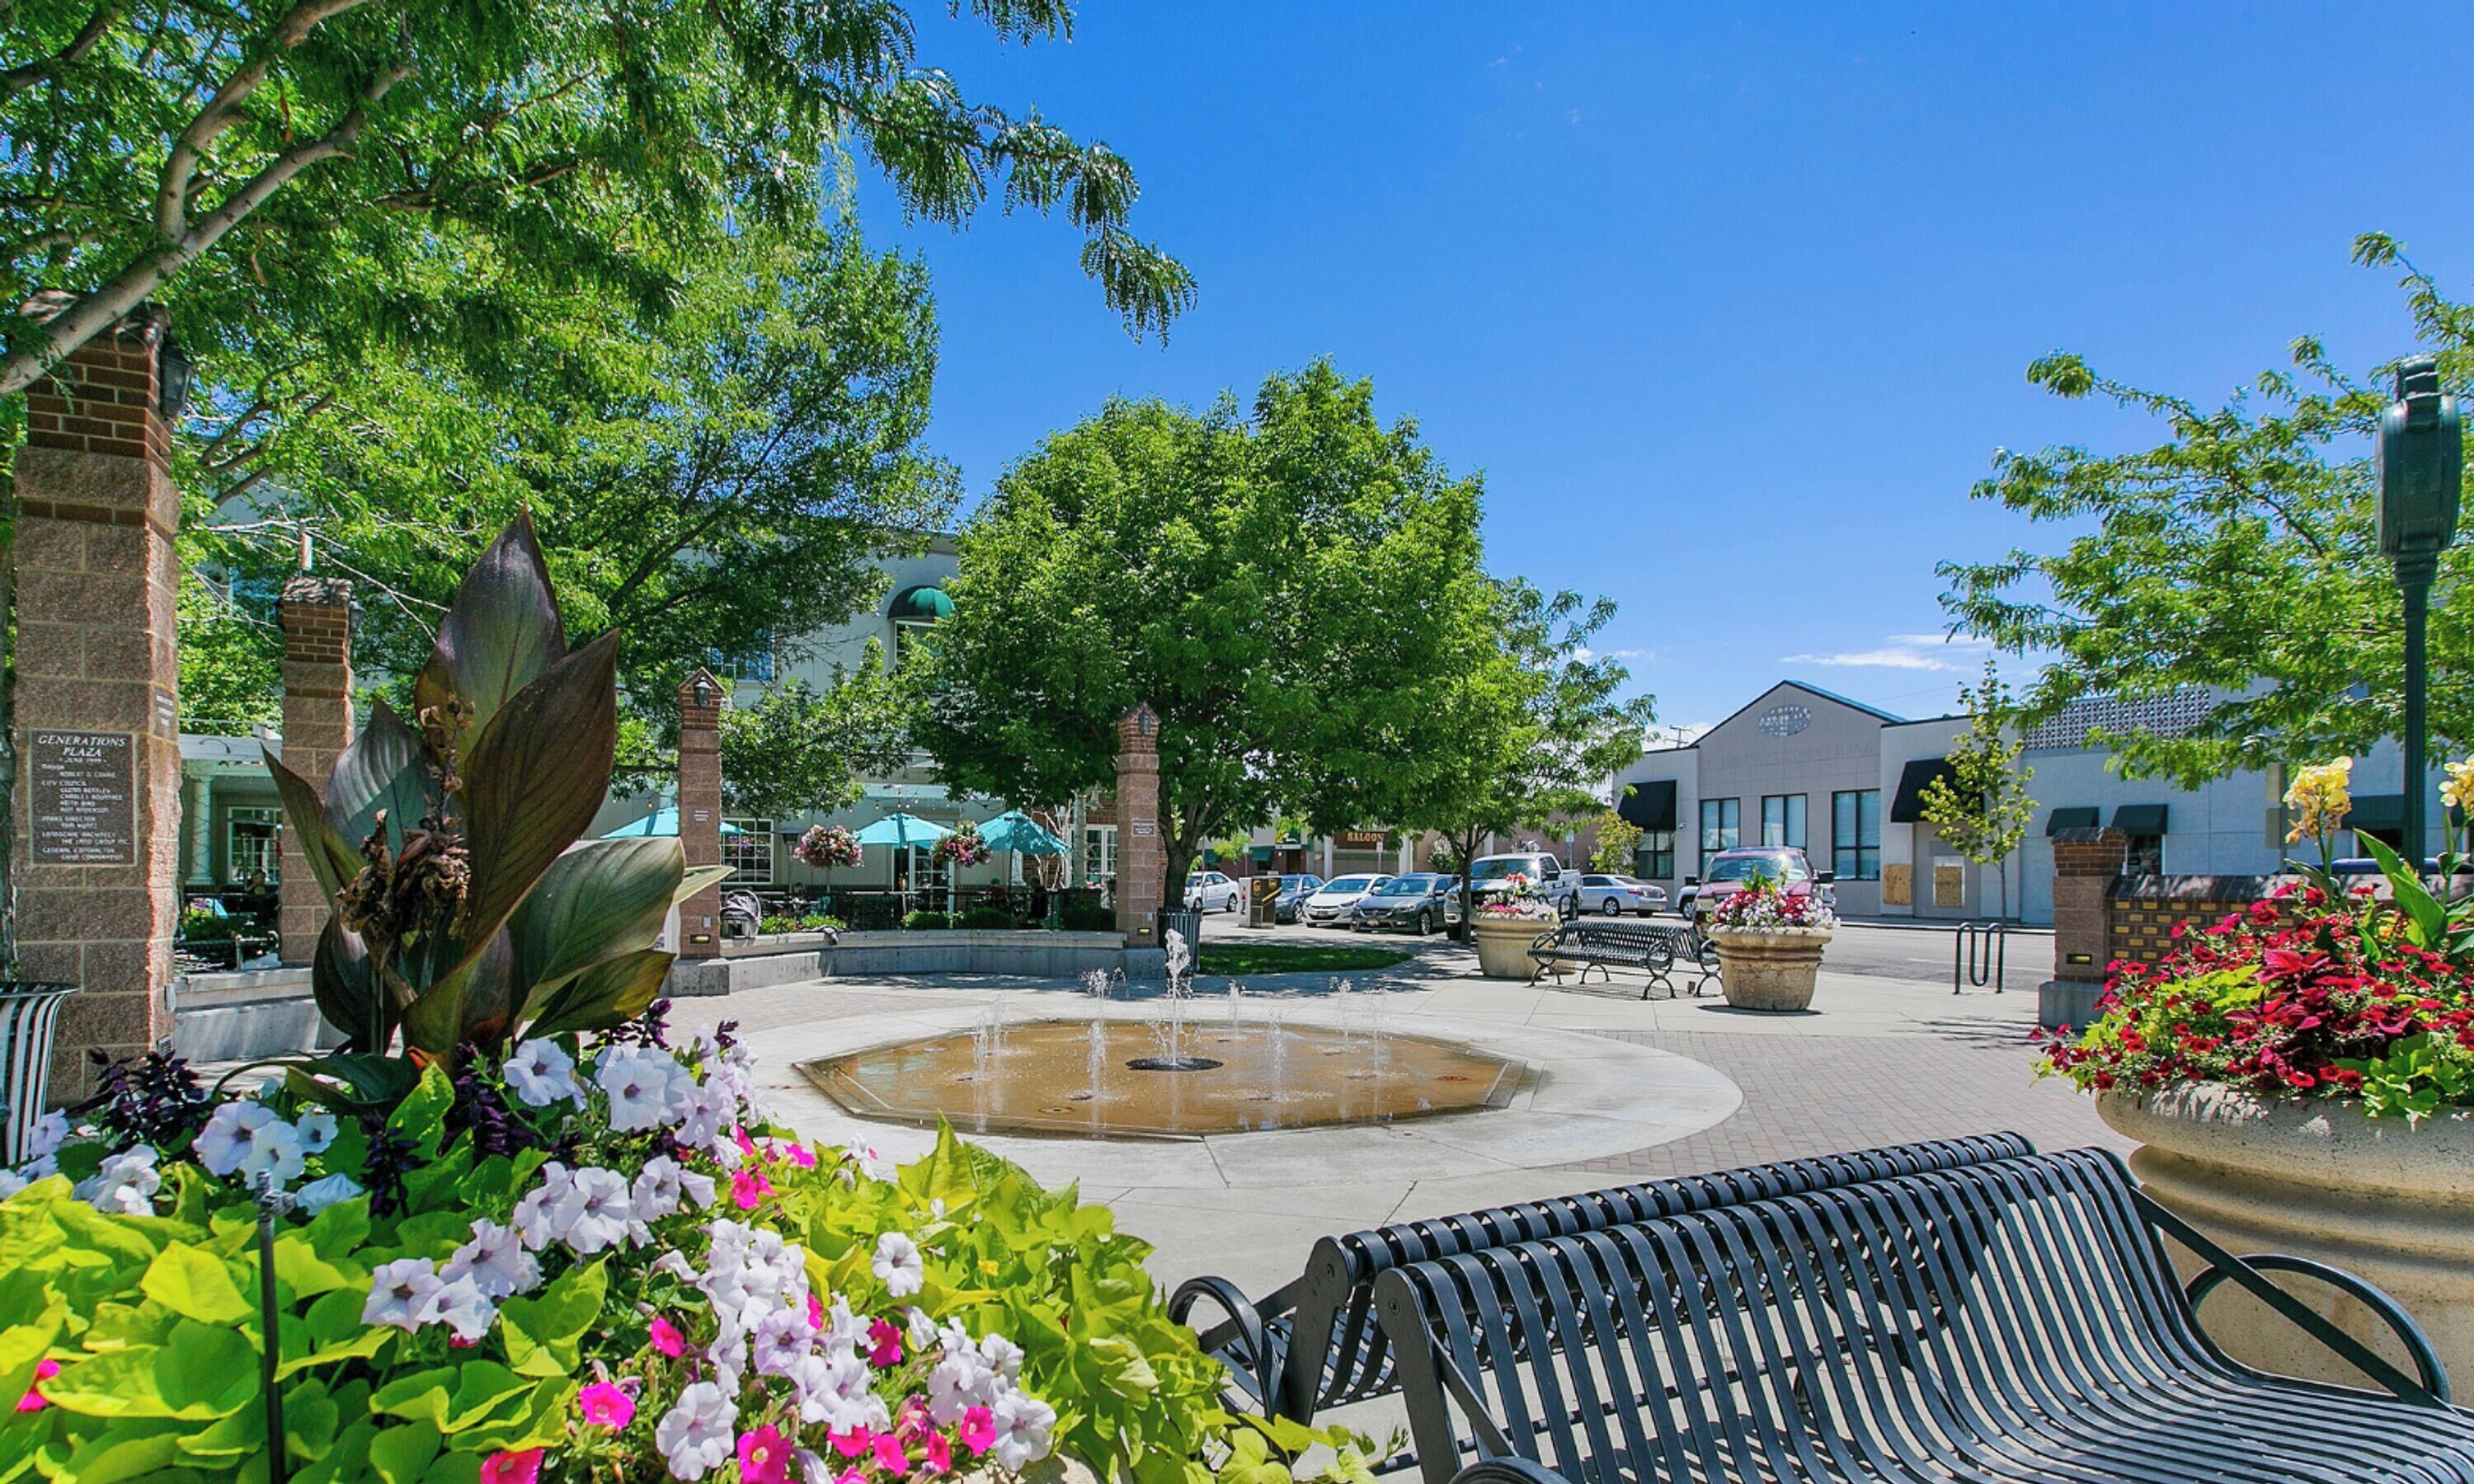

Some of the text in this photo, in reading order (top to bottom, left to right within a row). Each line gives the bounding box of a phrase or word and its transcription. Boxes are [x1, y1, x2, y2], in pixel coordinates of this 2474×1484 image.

[38, 734, 127, 747] GENERATIONS
[63, 747, 102, 757] PLAZA
[1347, 831, 1385, 842] SALOON
